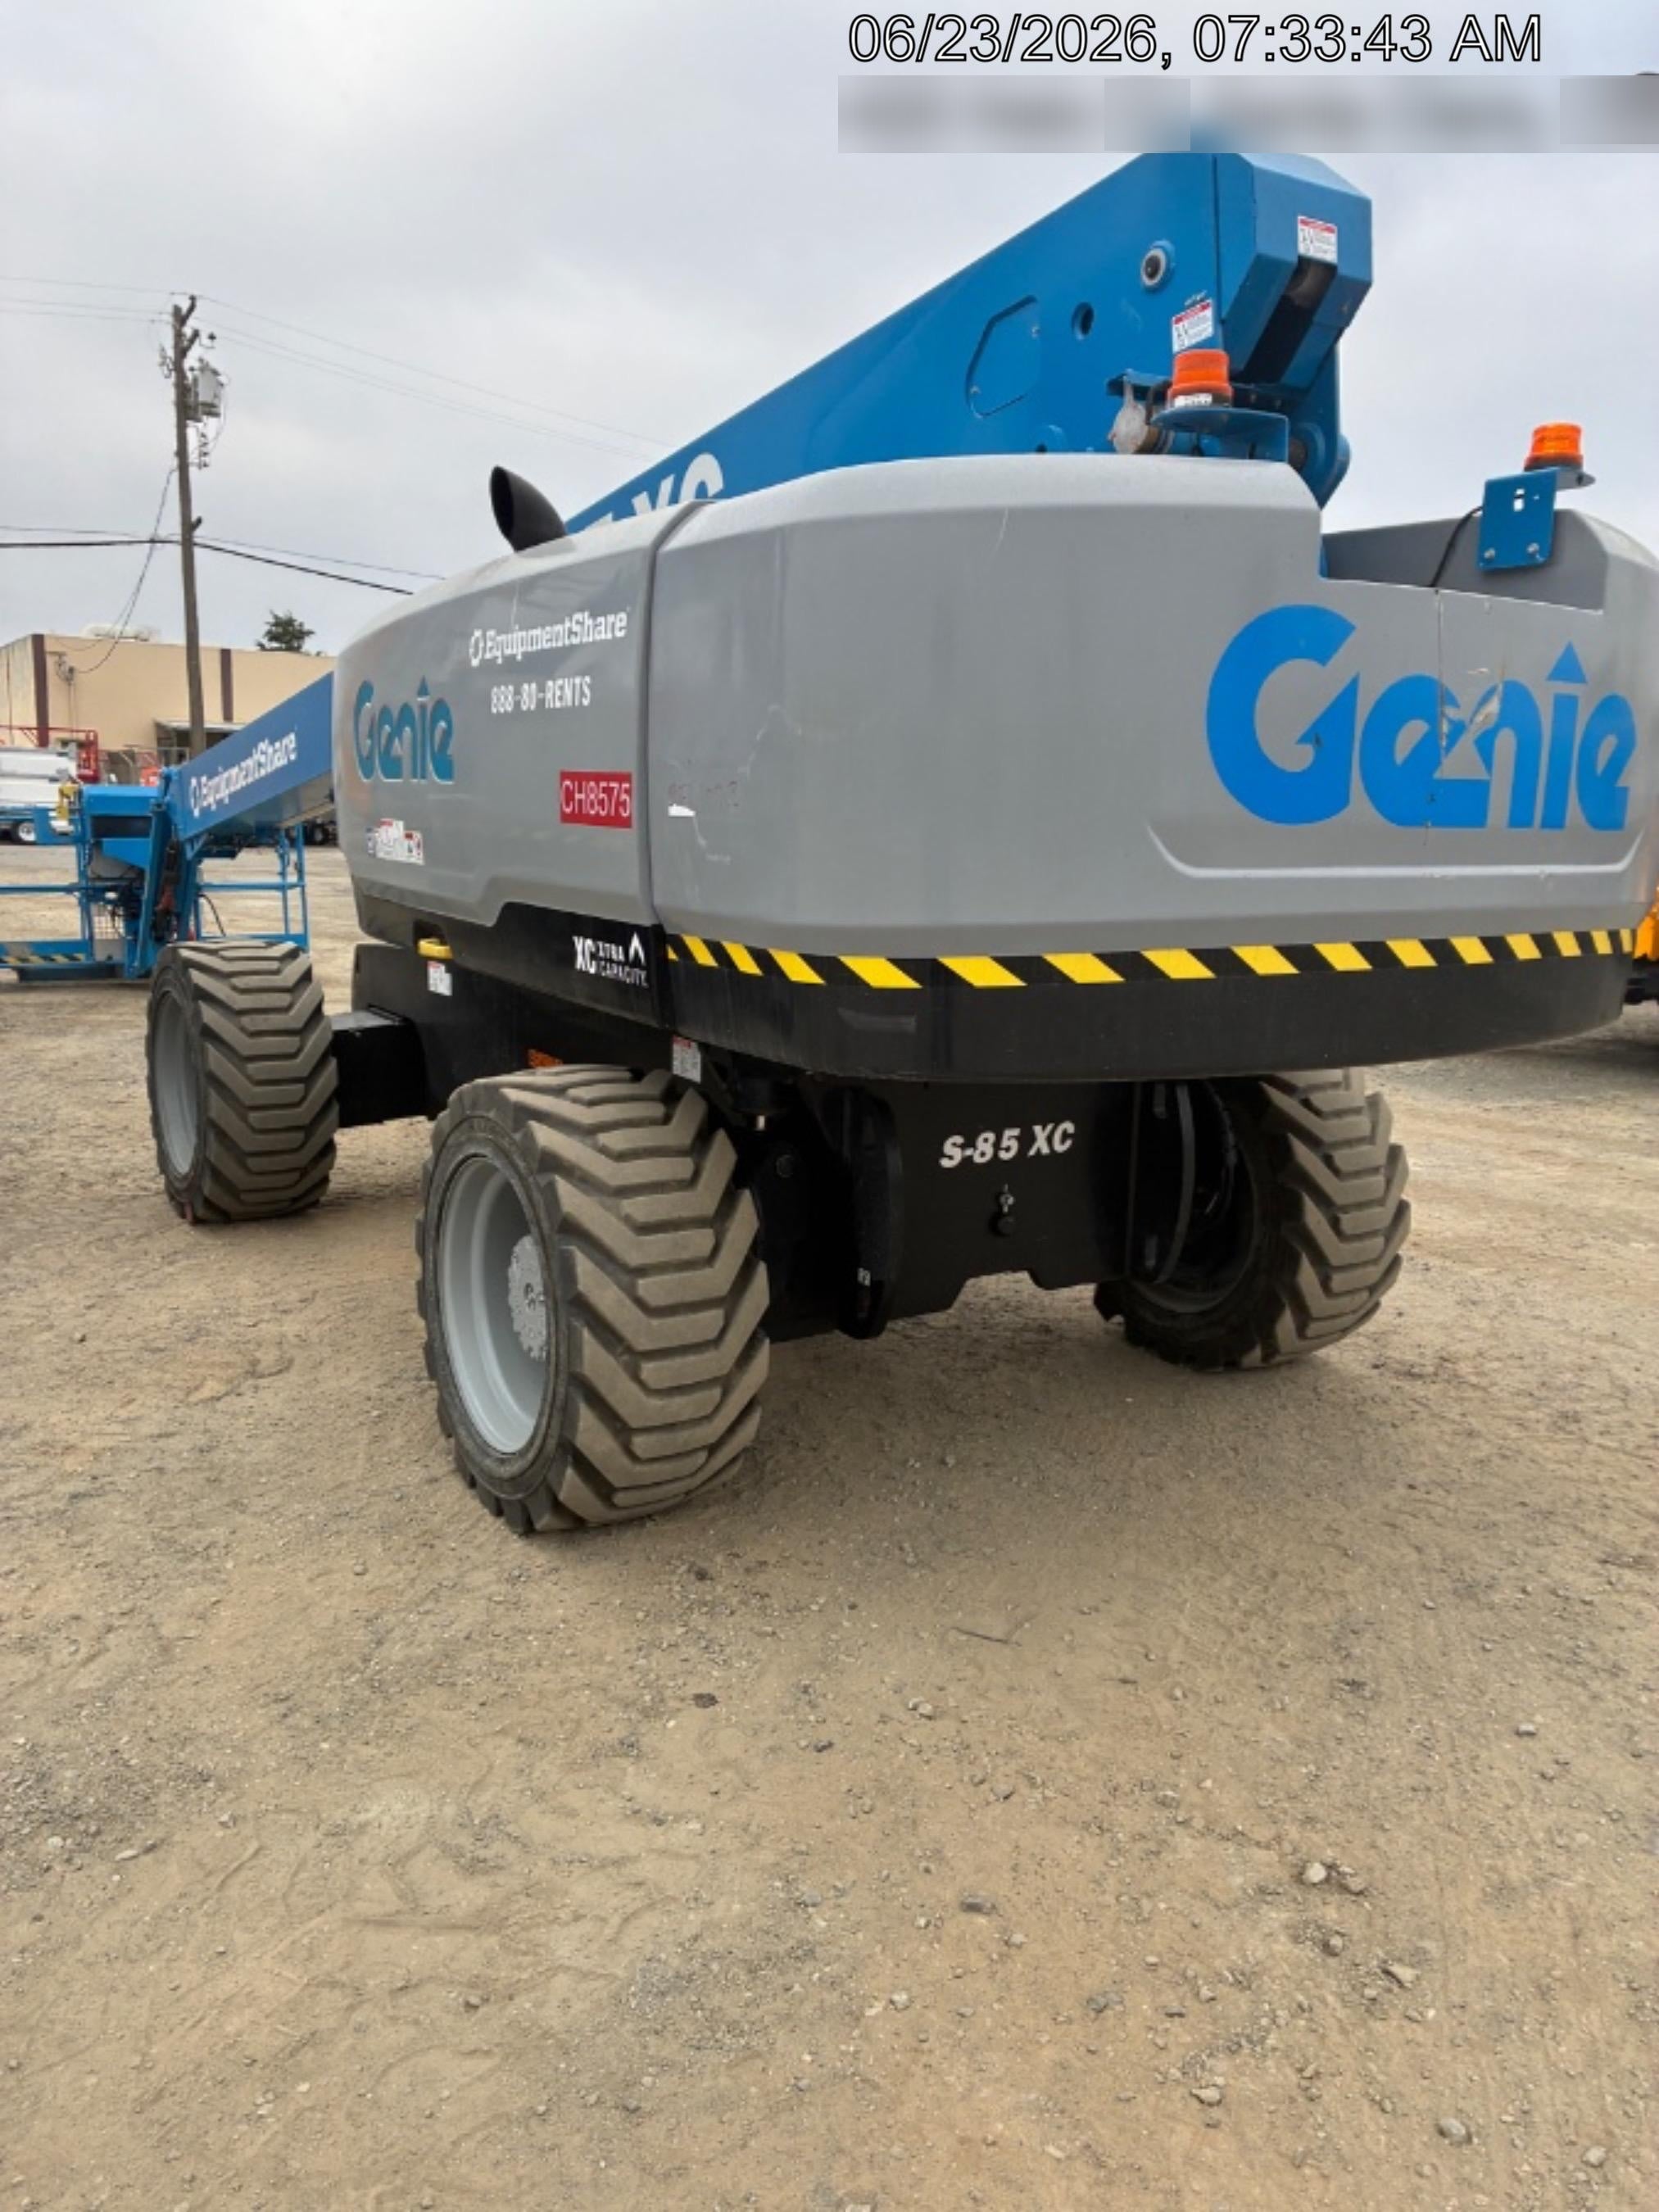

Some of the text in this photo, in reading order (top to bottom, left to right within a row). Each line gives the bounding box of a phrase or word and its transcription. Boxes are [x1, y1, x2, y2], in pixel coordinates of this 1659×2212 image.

[484, 611, 628, 664] EquipmentShare
[492, 675, 591, 714] 888-80-RENTS
[1207, 604, 1637, 832] Genie
[353, 675, 454, 784] Genie
[201, 732, 297, 810] EquipmentShare
[562, 780, 630, 817] CH8575
[572, 935, 596, 975] XC
[939, 1120, 1076, 1168] S-85 XC
